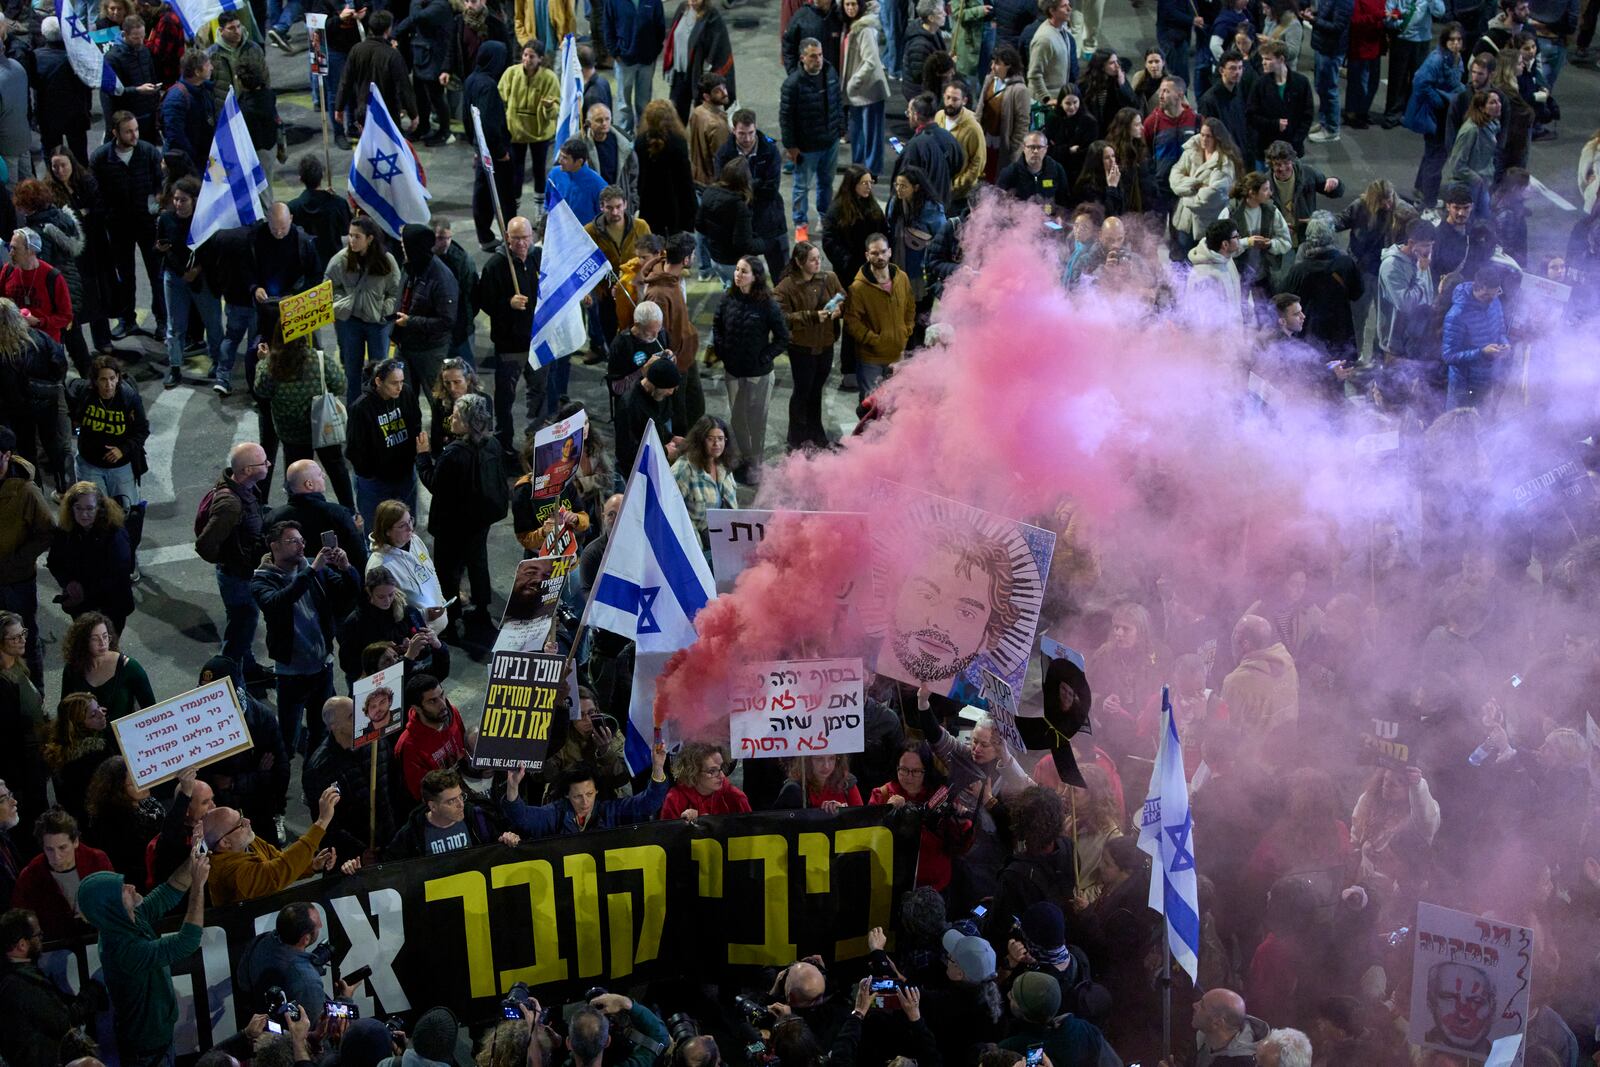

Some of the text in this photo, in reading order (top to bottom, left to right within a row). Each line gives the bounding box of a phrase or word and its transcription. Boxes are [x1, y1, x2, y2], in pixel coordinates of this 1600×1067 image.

[82, 416, 126, 435] עכשיו
[85, 404, 125, 422] הדחה
[493, 655, 563, 683] עופר בבית!
[770, 670, 801, 687] יהיה
[810, 668, 861, 690] בסוף
[982, 669, 1011, 698] STOP
[135, 689, 225, 729] כשתעמדו במשפטי
[487, 684, 557, 709] אבל מחזירים
[730, 689, 857, 713] אם עוד לא טוב
[145, 706, 222, 742] ניר עוז ותגידו:
[182, 725, 213, 743] מילאנו
[217, 714, 234, 731] "רק
[482, 707, 553, 740] את כולם!
[769, 714, 860, 737] סימן שזה
[137, 730, 241, 779] זה כבר לא יעזור לכם.
[741, 731, 829, 758] לא הסוף
[476, 757, 491, 766] UNTIL
[492, 758, 502, 766] THE
[503, 759, 517, 768] LAST
[430, 832, 468, 854] למה הם
[691, 825, 896, 967] ביבי
[424, 843, 667, 999] קובר
[1475, 920, 1512, 949] מר
